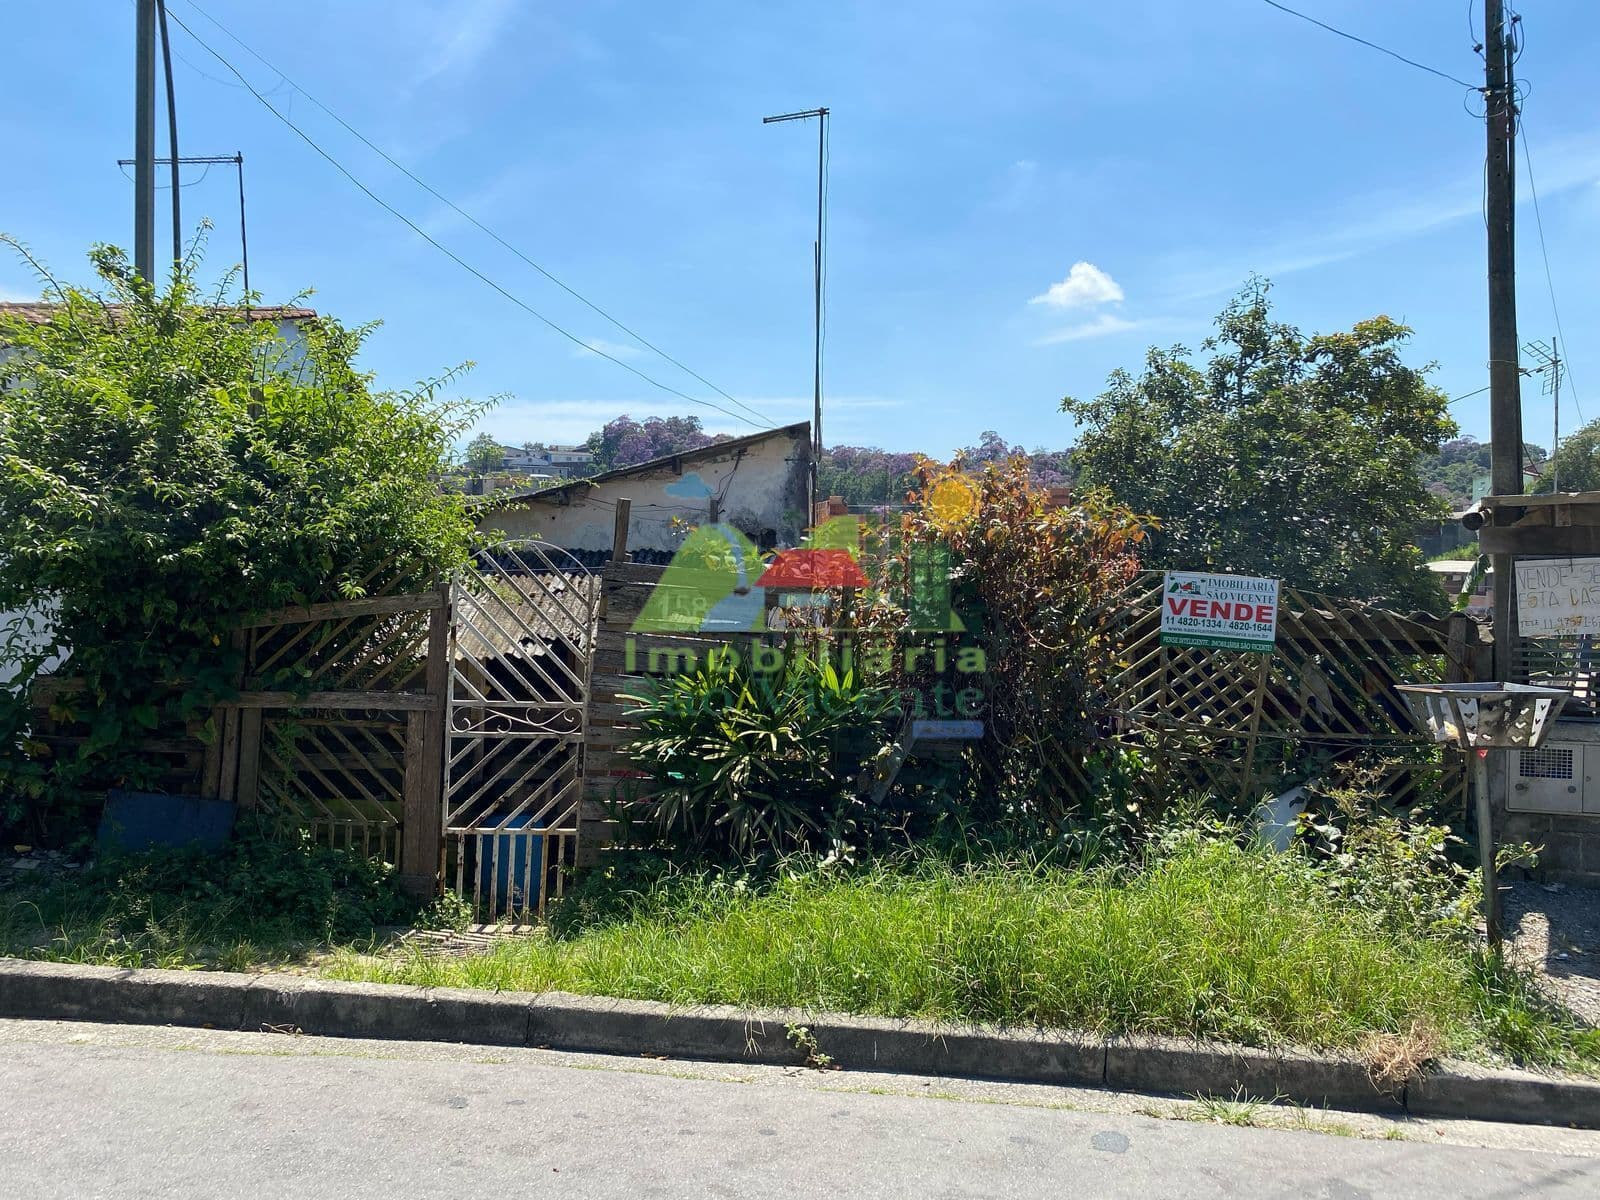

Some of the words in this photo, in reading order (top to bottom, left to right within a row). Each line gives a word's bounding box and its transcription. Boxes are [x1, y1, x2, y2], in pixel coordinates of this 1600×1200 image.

[1206, 589, 1228, 601] SÃO
[1230, 592, 1275, 604] VICENTE
[1167, 597, 1274, 623] VENDE
[1165, 616, 1175, 624] 11
[1178, 617, 1222, 628] 4820-1334
[1229, 620, 1273, 632] 4820-1644
